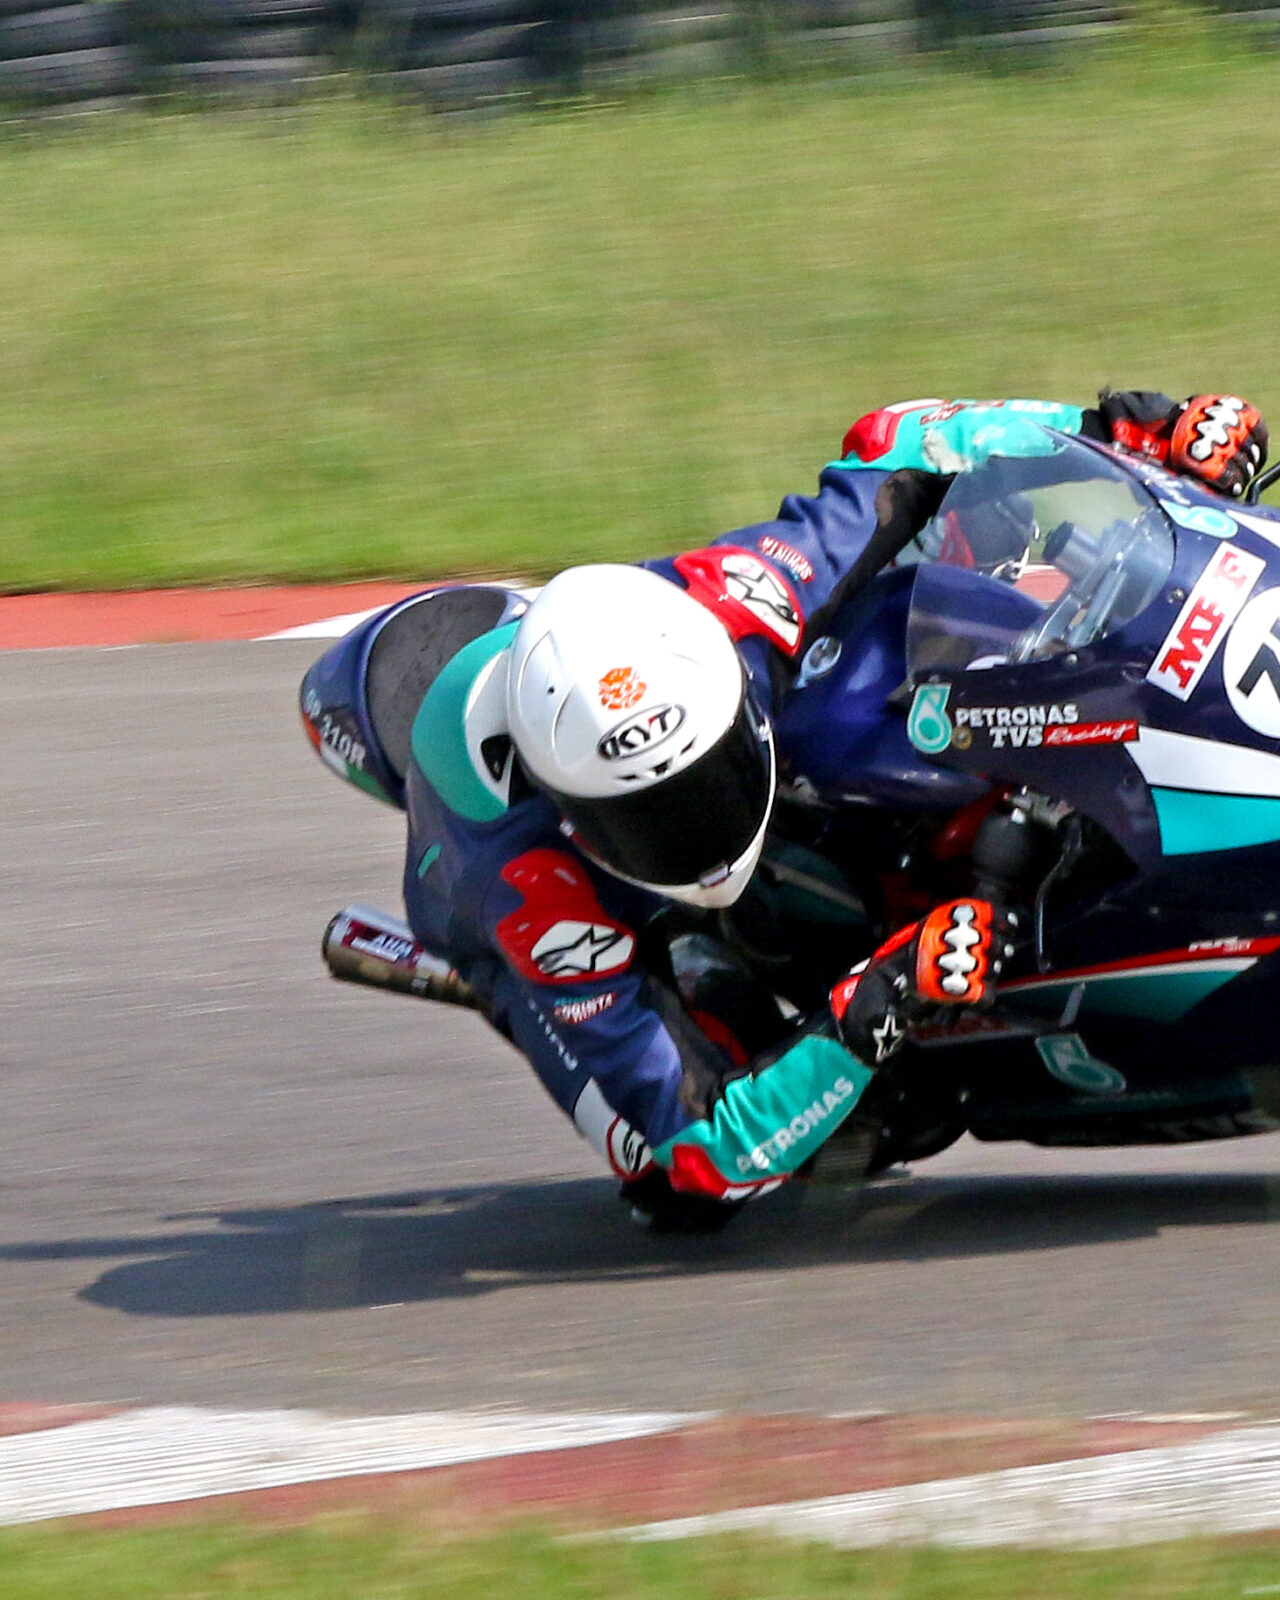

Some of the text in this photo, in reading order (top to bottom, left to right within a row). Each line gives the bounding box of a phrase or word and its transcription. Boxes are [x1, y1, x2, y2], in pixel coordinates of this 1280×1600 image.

[607, 705, 674, 758] KYT
[954, 703, 1080, 727] PETRONAS
[989, 723, 1136, 748] TVS Racing
[736, 1076, 855, 1174] PETRONAS
